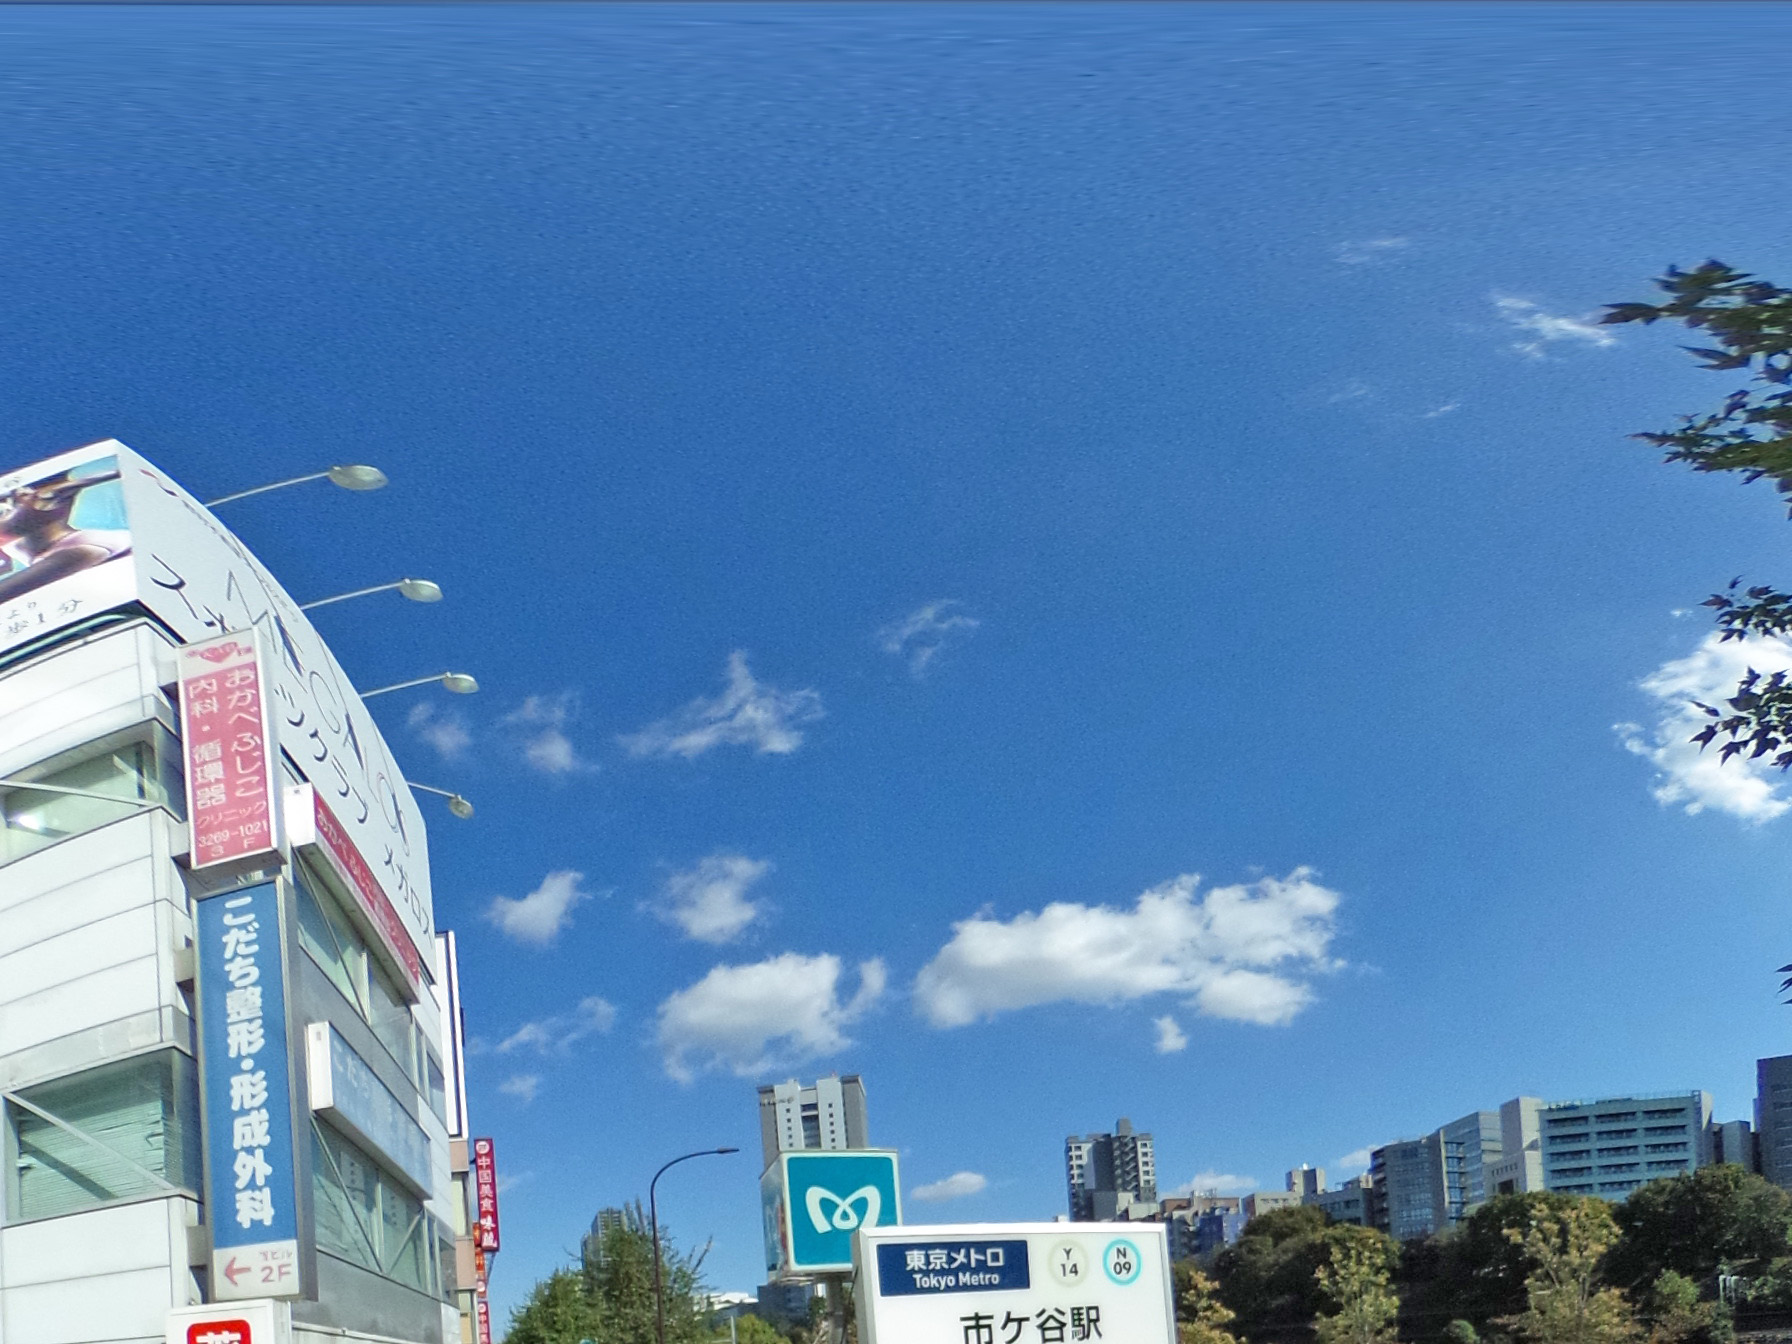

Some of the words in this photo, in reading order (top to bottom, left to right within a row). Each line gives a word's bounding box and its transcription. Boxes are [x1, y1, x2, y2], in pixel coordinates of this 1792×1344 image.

[227, 568, 411, 858] MEGALOS
[189, 678, 227, 810] 内科・循環器
[225, 668, 264, 798] おかべふじこ
[196, 801, 267, 829] クリニック
[197, 821, 268, 848] 3269-1021
[222, 895, 275, 1230] こだち整形・形成外科
[904, 1247, 1005, 1271] 東京メトロ
[1063, 1247, 1073, 1260] Y
[1116, 1248, 1127, 1260] N
[260, 1263, 293, 1283] 2F
[912, 1273, 956, 1291] Tokyo
[958, 1270, 1000, 1288] Metro
[1060, 1262, 1079, 1278] 14
[1113, 1261, 1132, 1276] 09
